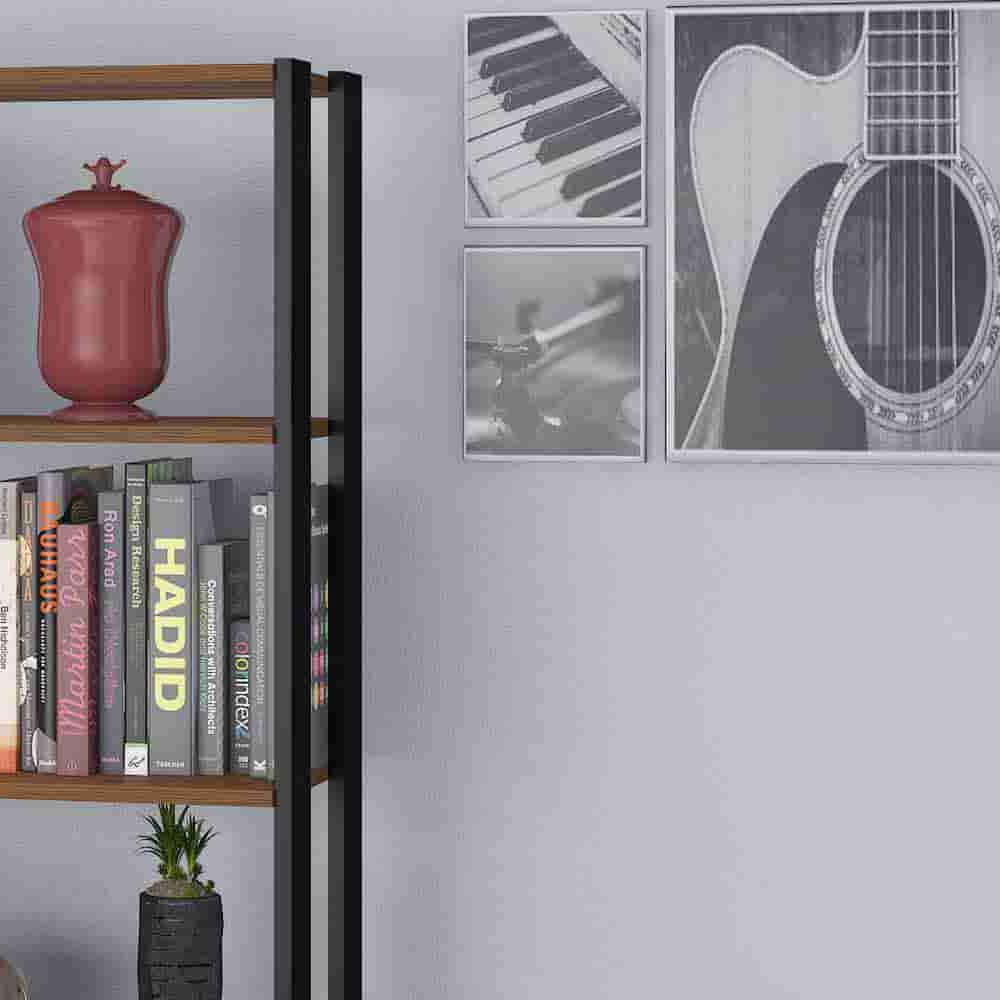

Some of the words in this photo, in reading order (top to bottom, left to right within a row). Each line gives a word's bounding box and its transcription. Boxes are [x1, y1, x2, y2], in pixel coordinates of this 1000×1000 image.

[104, 509, 117, 543] Ron
[129, 494, 143, 542] Design
[39, 500, 57, 615] BAUHAUS
[104, 547, 117, 589] Arad
[130, 544, 143, 609] Research
[154, 536, 186, 712] HADID
[207, 579, 217, 655] Conversations
[57, 617, 88, 736] Martin
[207, 657, 217, 679] with
[207, 682, 217, 735] Architects
